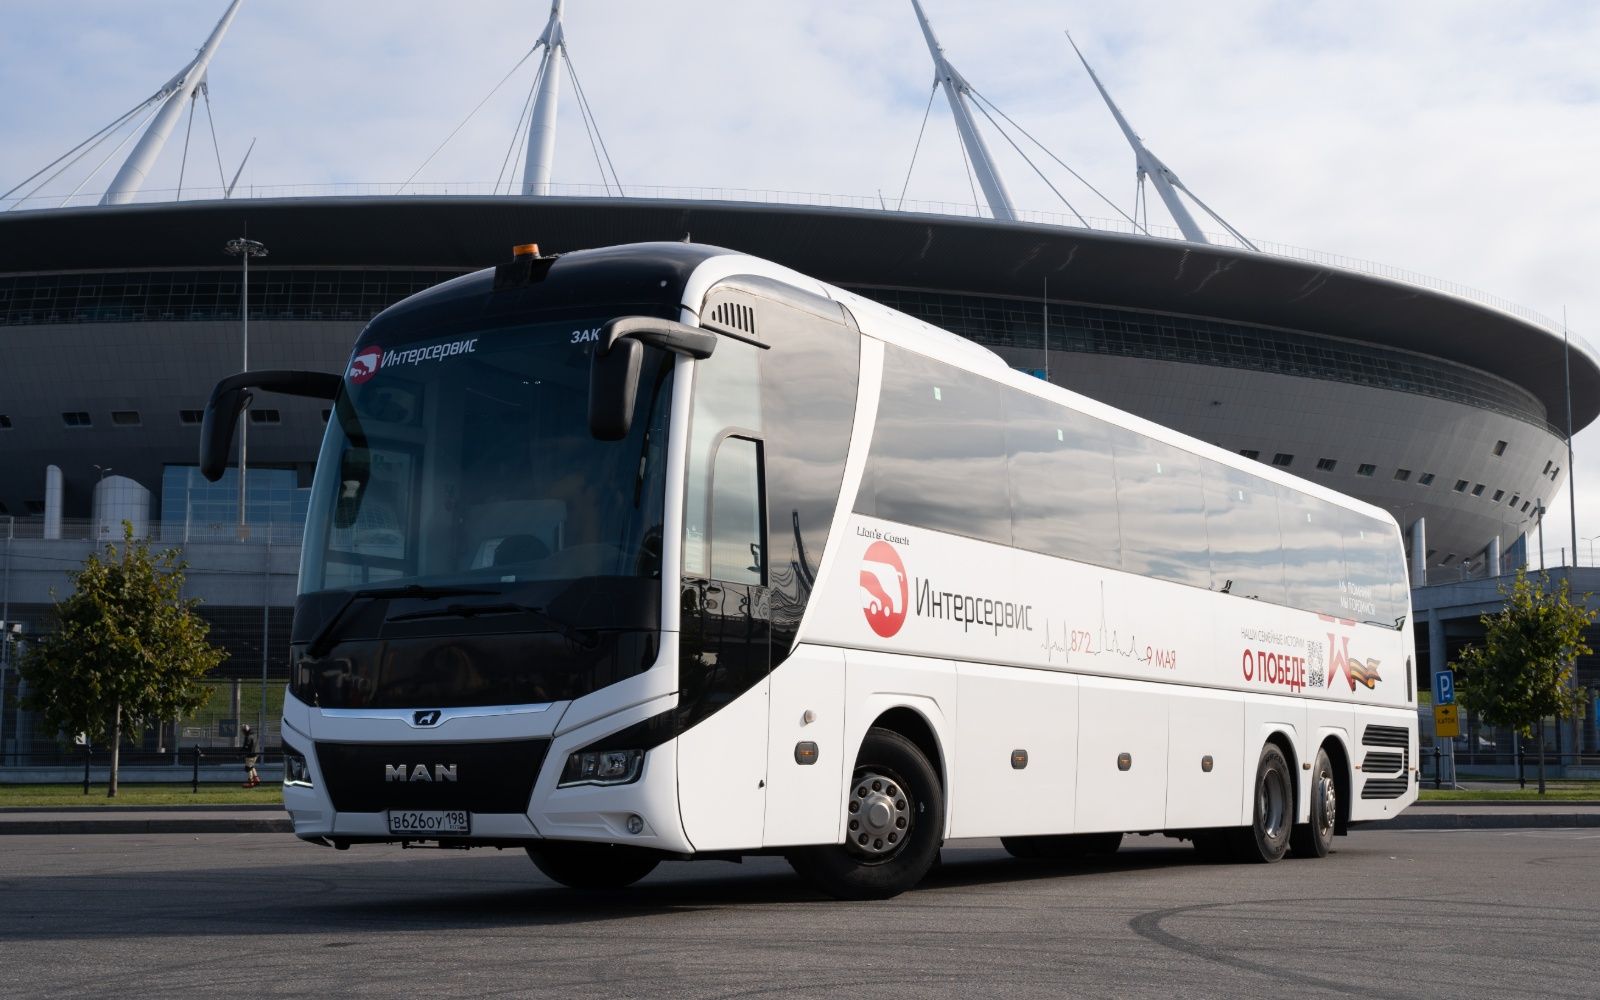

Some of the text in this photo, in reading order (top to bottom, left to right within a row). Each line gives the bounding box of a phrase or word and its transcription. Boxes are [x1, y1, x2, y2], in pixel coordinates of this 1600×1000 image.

[571, 328, 602, 343] ЗАК
[380, 339, 478, 368] Интерсервис
[857, 526, 910, 546] Lion's Coach
[915, 576, 1033, 637] Интерсервис
[1070, 629, 1092, 654] 872
[1146, 645, 1177, 670] 9 МАЯ
[1242, 648, 1307, 694] О ПОБЕДЕ
[1440, 675, 1450, 700] P
[385, 763, 458, 782] MAN
[445, 812, 465, 825] 198
